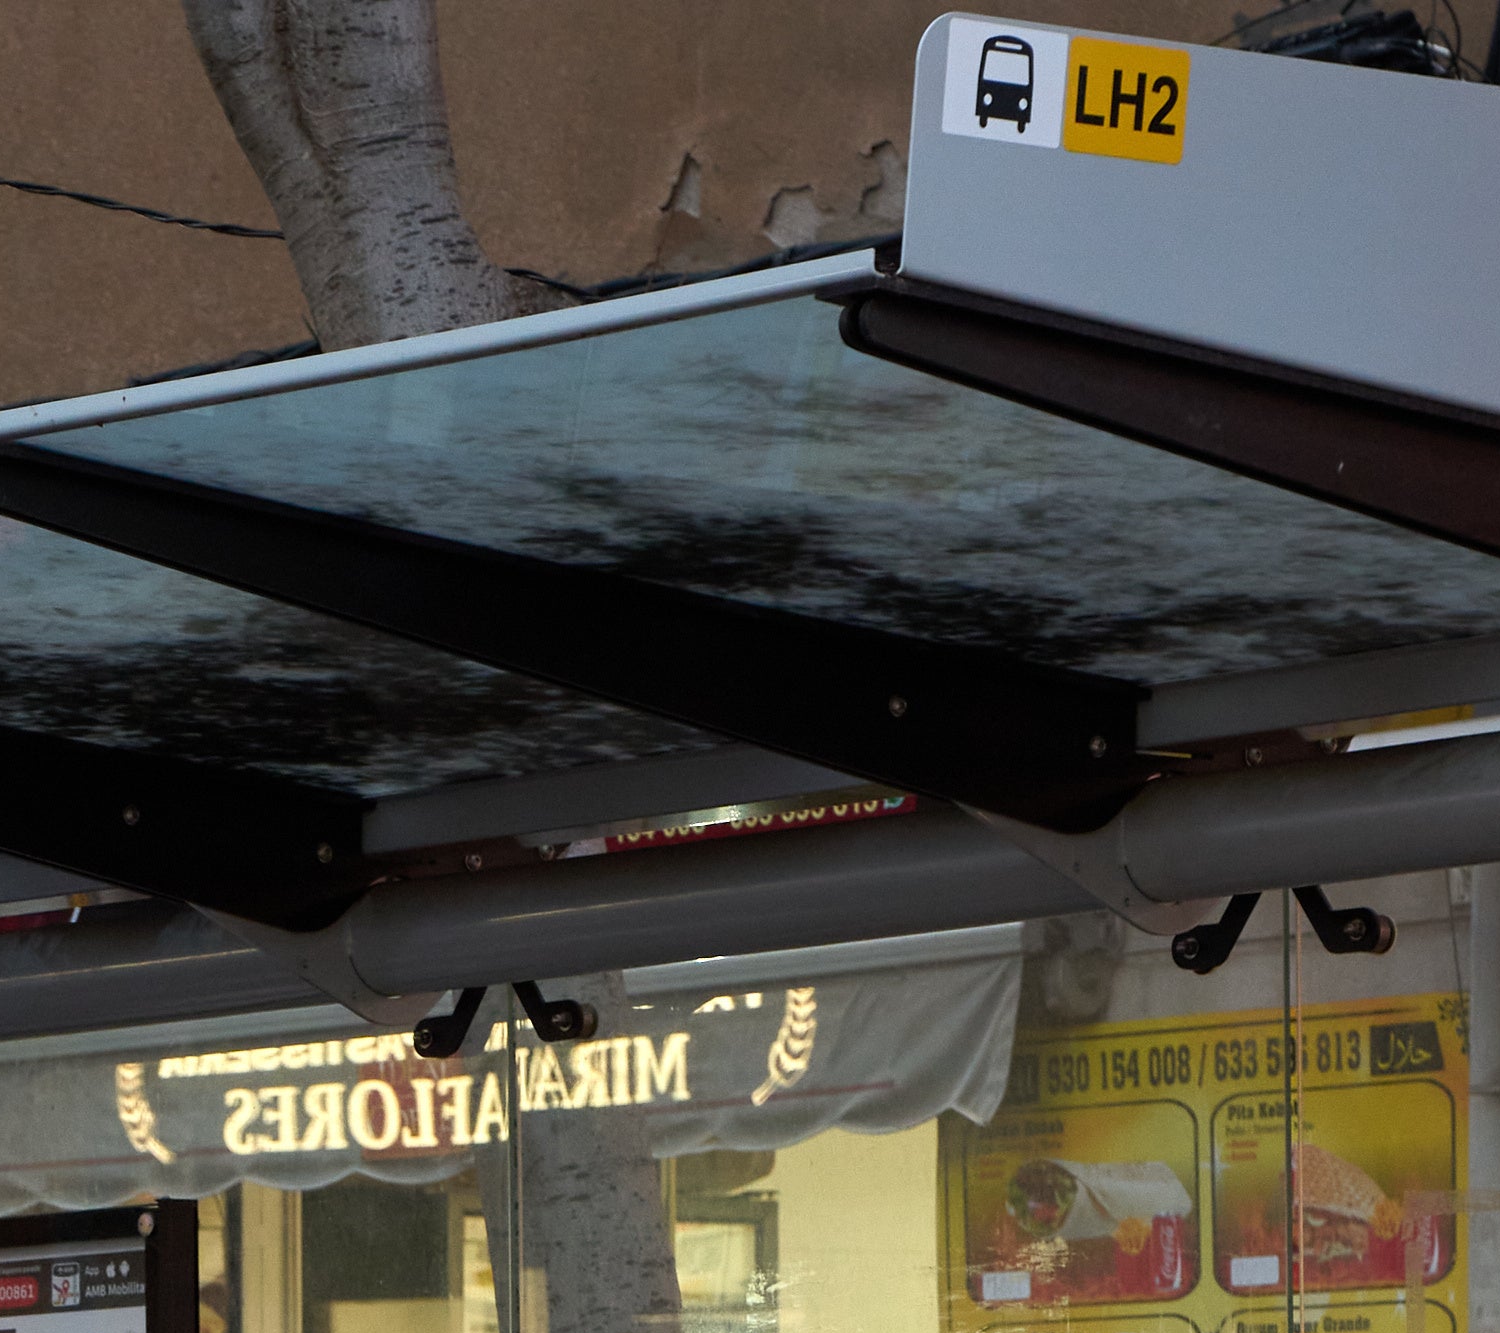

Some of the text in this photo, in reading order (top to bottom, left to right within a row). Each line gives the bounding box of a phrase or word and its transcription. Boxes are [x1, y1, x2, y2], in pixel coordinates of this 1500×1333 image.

[1075, 65, 1179, 135] LH2
[1047, 1054, 1090, 1094] 930
[1101, 1050, 1140, 1090] 154
[1149, 1045, 1192, 1086] 008
[1214, 1039, 1258, 1081] 633
[1317, 1030, 1361, 1073] 813
[85, 1286, 106, 1298] AMB
[1323, 1316, 1371, 1332] Grande
